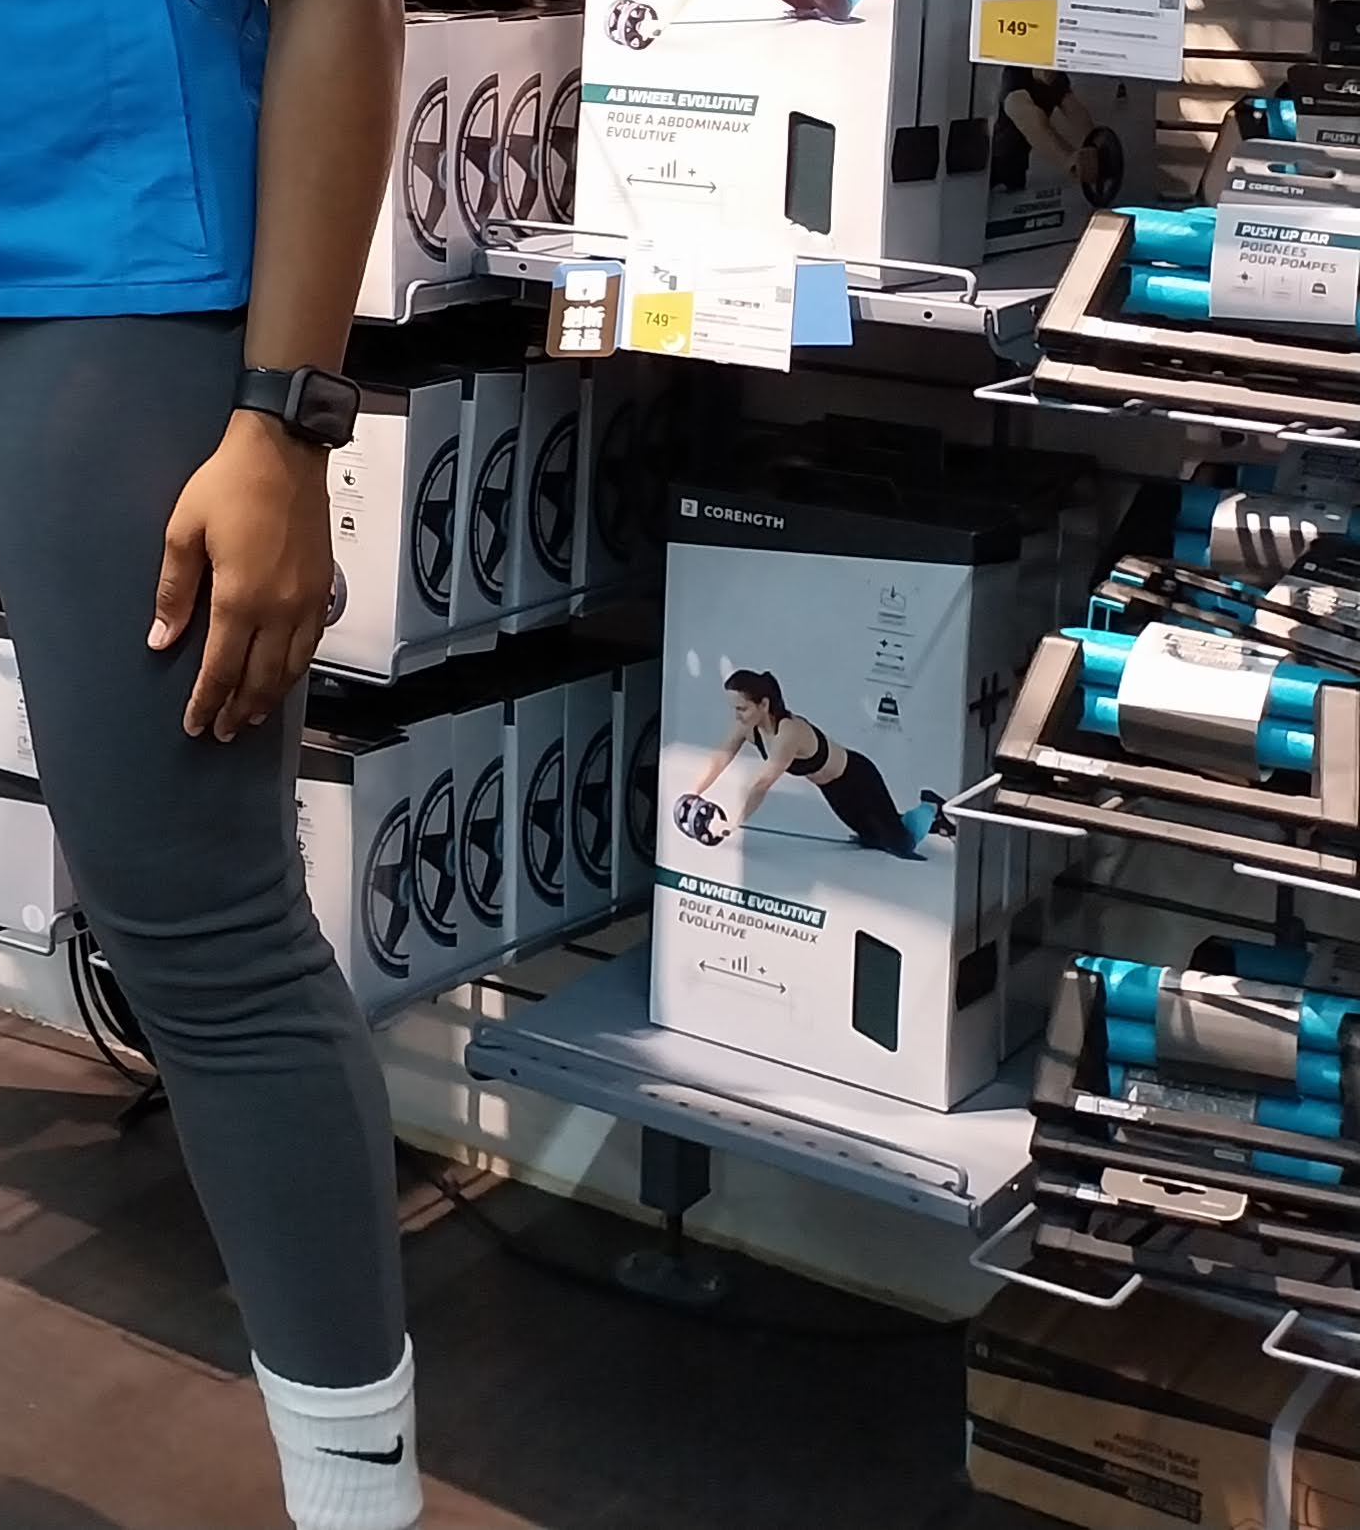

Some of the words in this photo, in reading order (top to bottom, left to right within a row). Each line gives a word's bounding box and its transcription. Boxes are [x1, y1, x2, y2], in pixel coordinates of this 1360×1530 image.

[998, 19, 1027, 36] 149
[605, 87, 626, 102] AB
[628, 89, 676, 106] WHEEL
[677, 93, 755, 112] EVOLUTIVE
[607, 111, 642, 125] ROUE
[657, 115, 751, 133] ABDOMINAUX
[1241, 224, 1278, 239] PUSH
[1279, 229, 1300, 241] UP
[1300, 231, 1330, 245] BAR
[1239, 252, 1277, 266] POUR
[1280, 257, 1338, 275] POMPES
[644, 311, 669, 327] 749
[703, 505, 785, 530] CORENGTH
[678, 876, 698, 892] AB
[699, 881, 747, 907] WHEEL
[747, 895, 822, 925] EVOLUTIVE
[678, 898, 713, 916] ROUE
[727, 911, 819, 945] ABDOMINAUX
